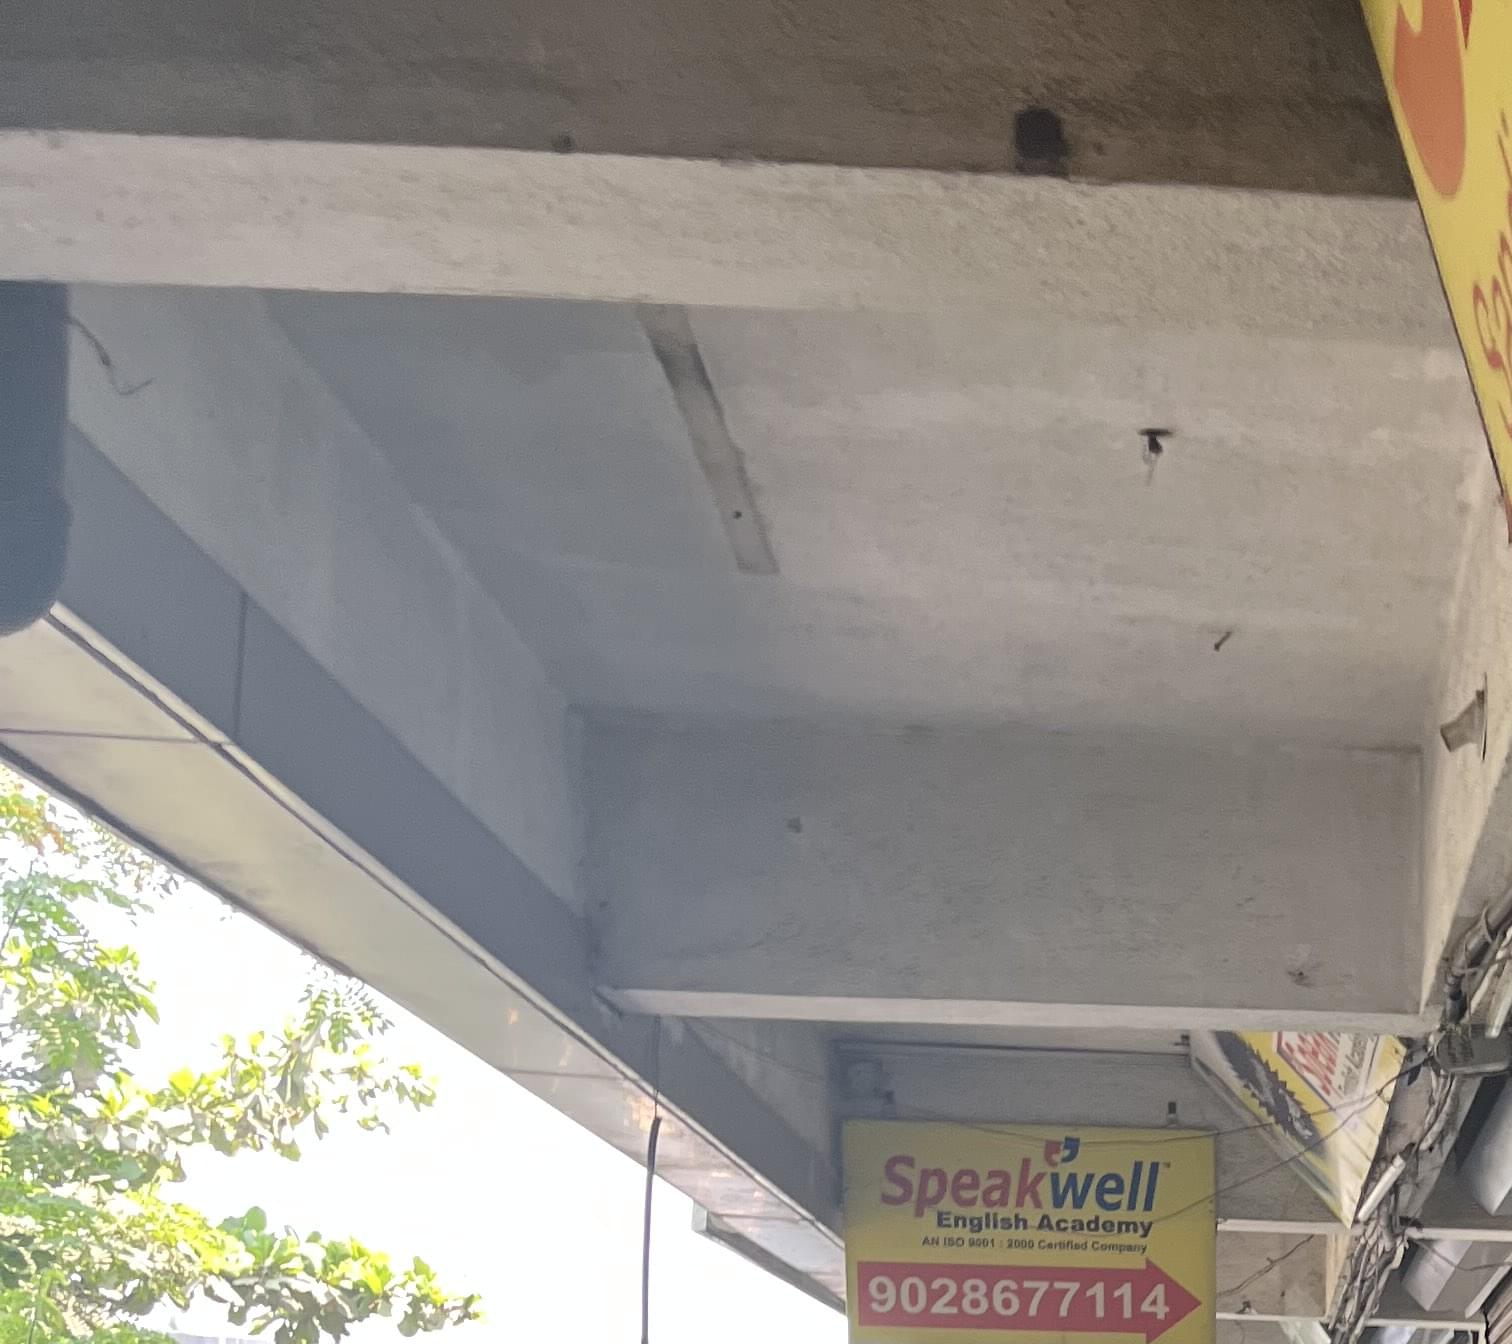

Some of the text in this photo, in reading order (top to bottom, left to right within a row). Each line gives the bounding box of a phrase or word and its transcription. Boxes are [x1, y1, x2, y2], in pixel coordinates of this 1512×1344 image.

[881, 1154, 1159, 1218] Speakwell
[937, 1210, 1153, 1238] English Academy
[921, 1236, 940, 1247] AN
[943, 1237, 965, 1248] ISO
[968, 1237, 995, 1248] 9001
[1006, 1239, 1035, 1250] 2000
[1038, 1239, 1088, 1252] Certified
[1091, 1241, 1148, 1255] Company
[868, 1275, 1170, 1321] 9028677114
